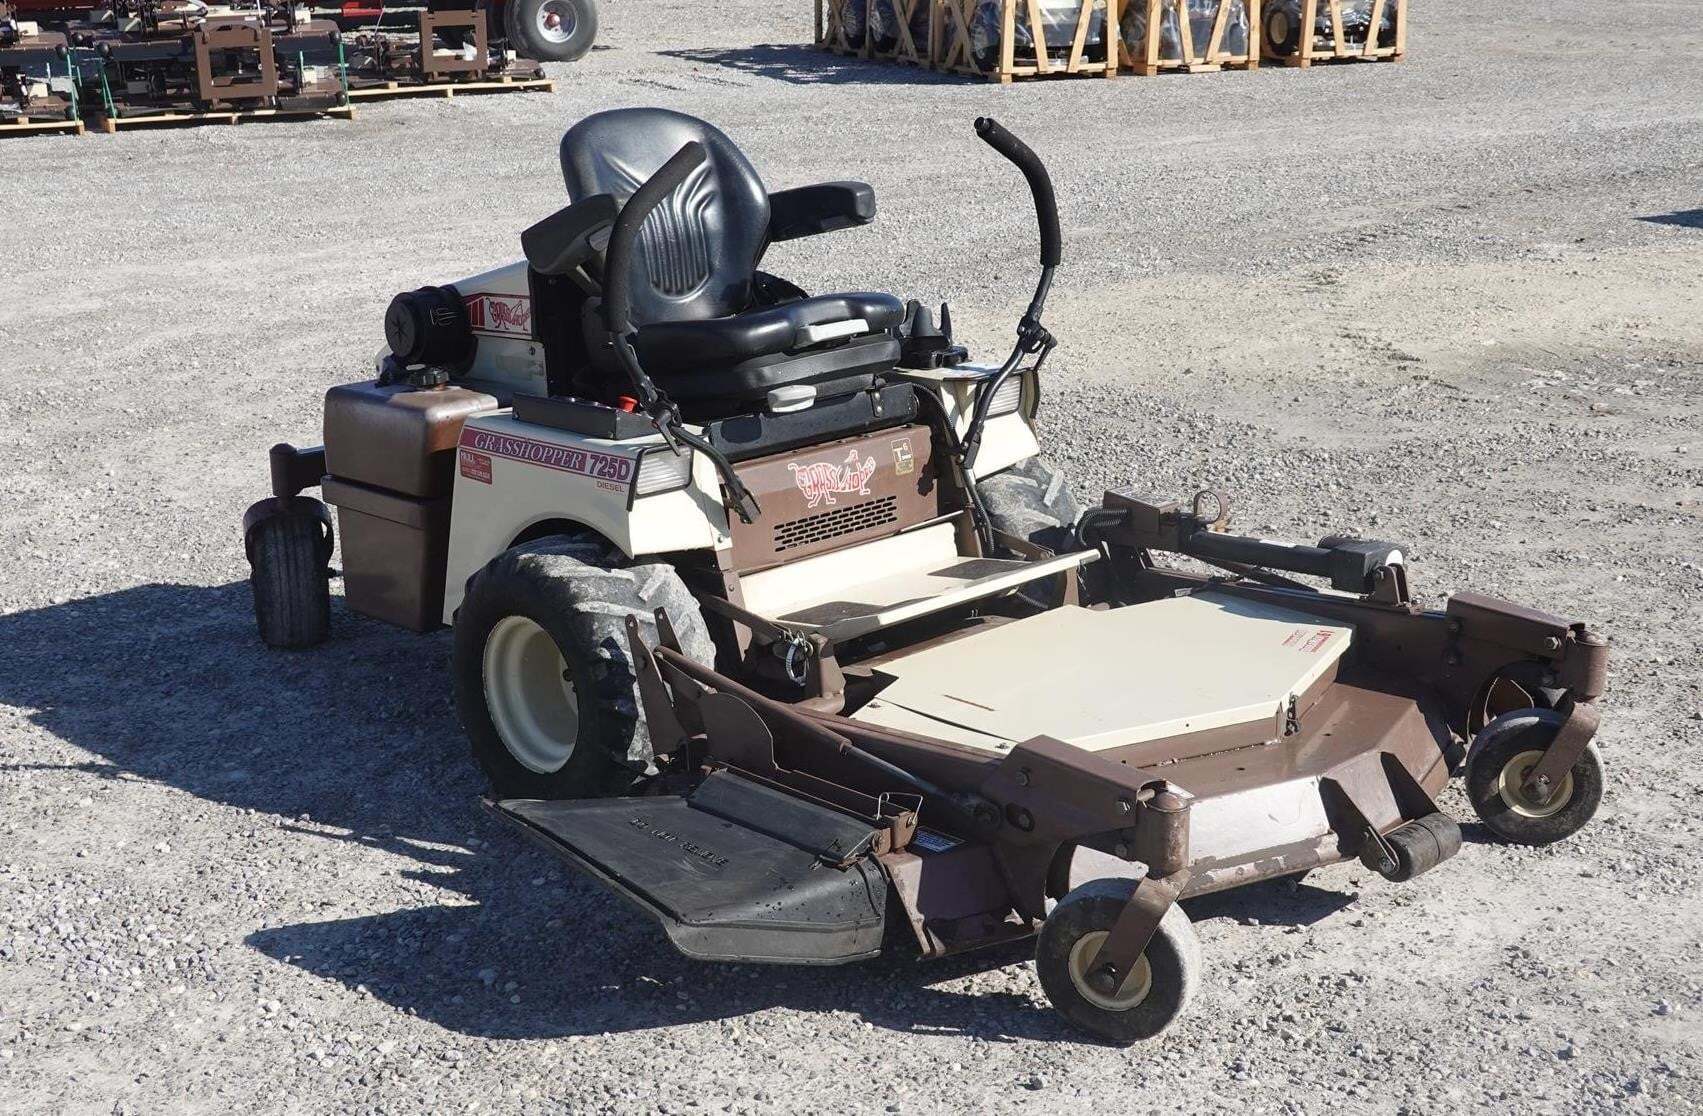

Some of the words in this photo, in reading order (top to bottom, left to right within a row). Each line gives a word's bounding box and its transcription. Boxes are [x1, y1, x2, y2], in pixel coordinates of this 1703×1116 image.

[475, 433, 581, 470] GRASSHOPPER
[589, 455, 630, 481] 725D
[596, 480, 625, 493] DIESEL
